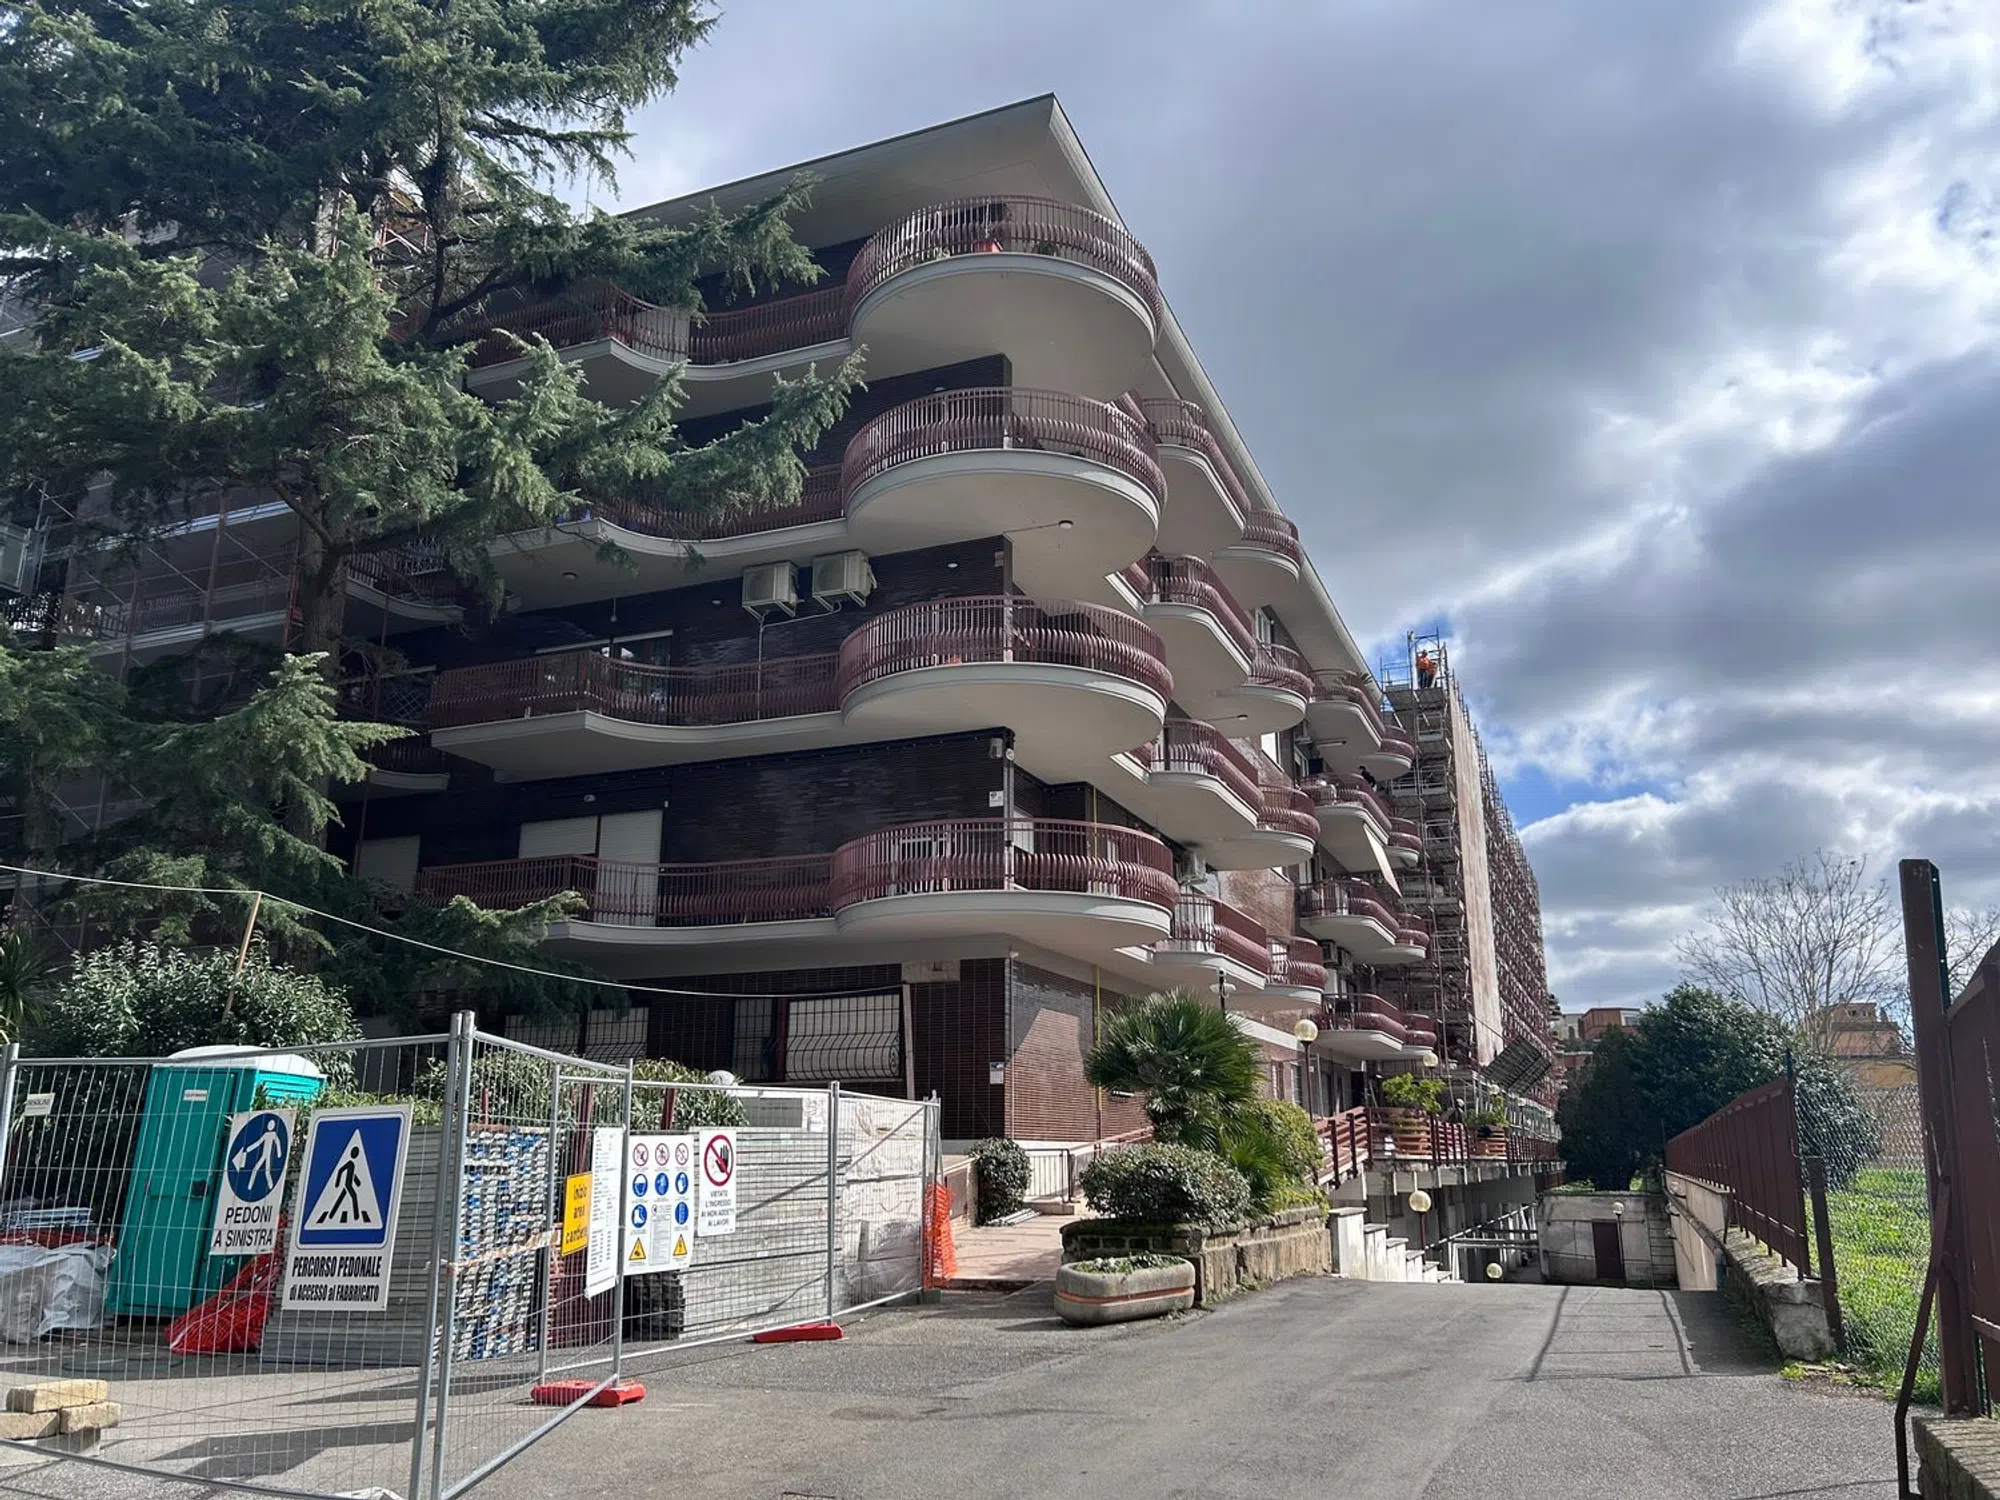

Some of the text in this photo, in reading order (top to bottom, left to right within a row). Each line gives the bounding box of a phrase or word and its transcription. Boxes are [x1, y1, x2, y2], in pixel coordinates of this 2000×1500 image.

[710, 1189, 728, 1198] VIETATO
[573, 1205, 585, 1219] area
[705, 1199, 731, 1208] L'INGRESSO
[225, 1206, 273, 1224] PEDONI
[213, 1228, 274, 1247] A SINISTRA
[292, 1256, 382, 1278] PERCORSO PEDONALE
[290, 1284, 380, 1302] di ACCESSO al FABBRICATO
